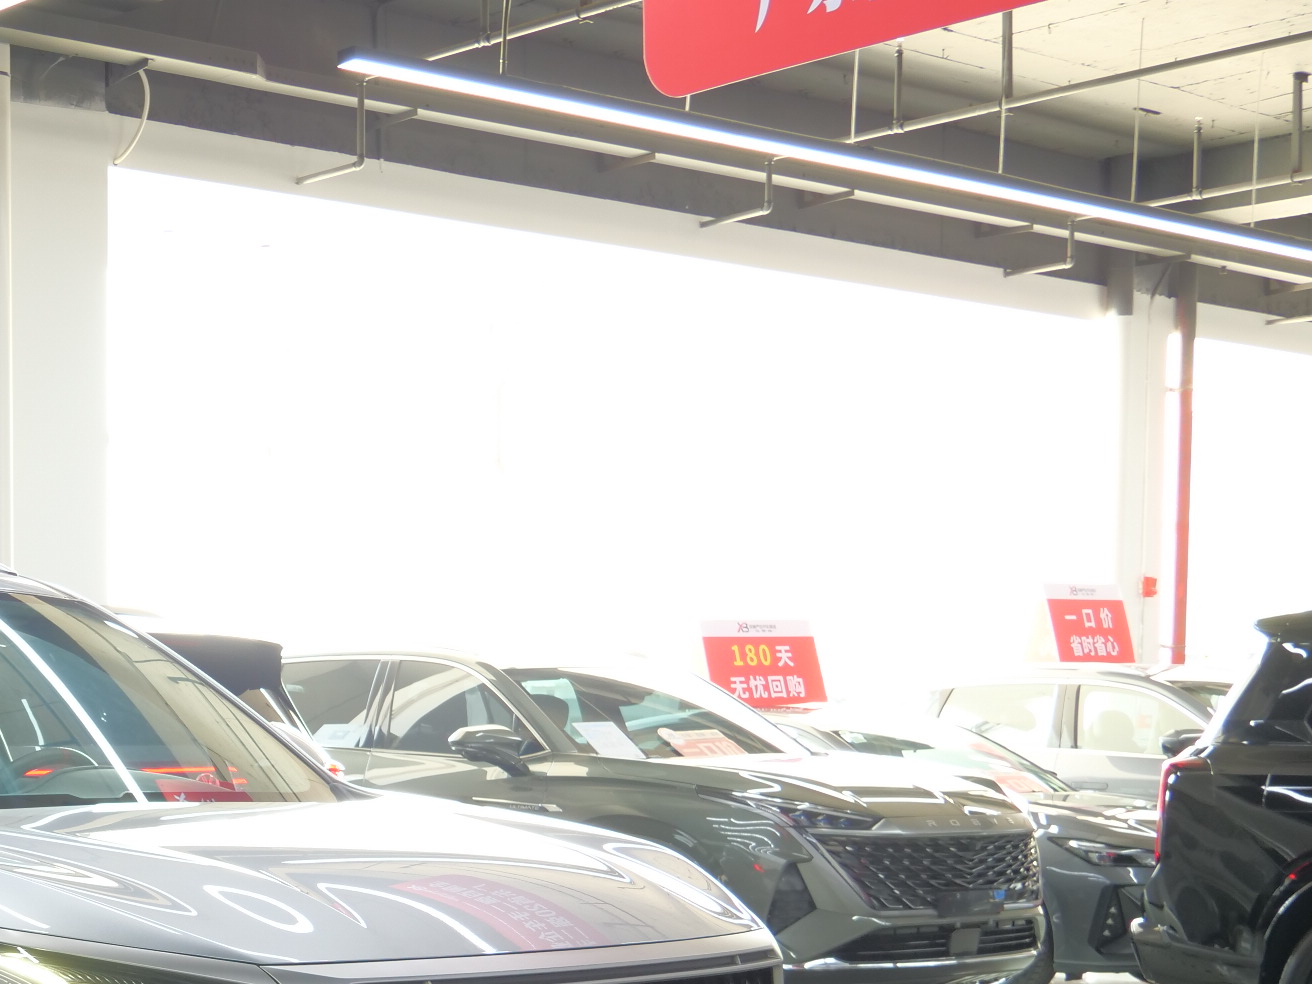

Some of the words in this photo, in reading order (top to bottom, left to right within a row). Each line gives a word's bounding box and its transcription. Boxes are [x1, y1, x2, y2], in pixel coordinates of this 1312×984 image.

[1064, 607, 1113, 629] 一口价
[1070, 634, 1119, 656] 省时省心
[730, 674, 806, 698] 无忧回购
